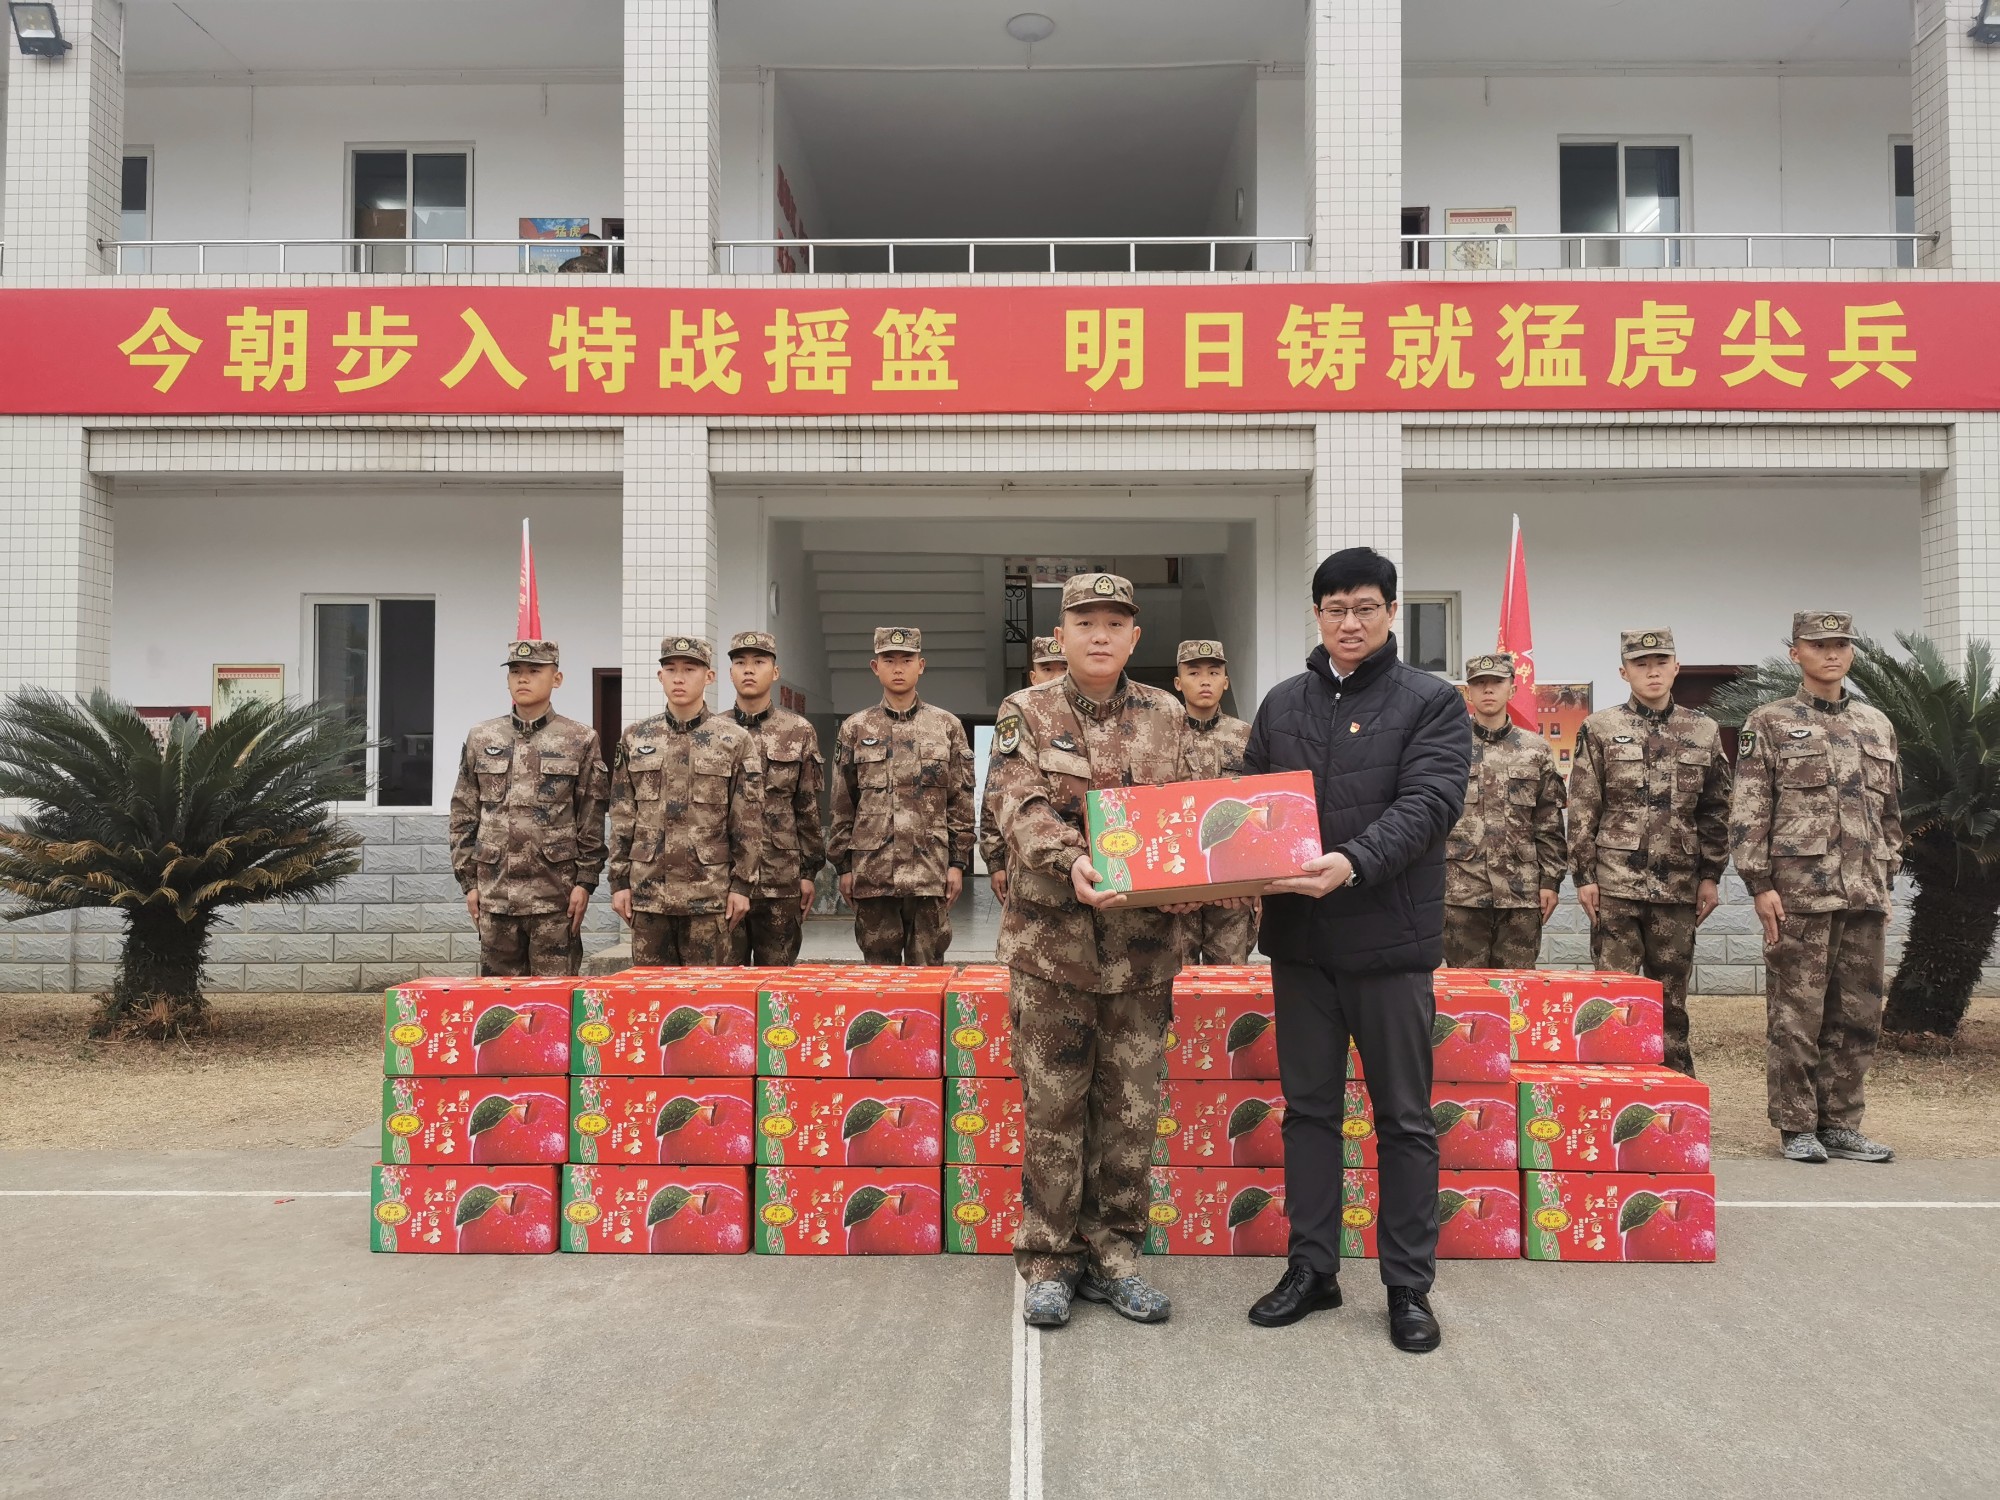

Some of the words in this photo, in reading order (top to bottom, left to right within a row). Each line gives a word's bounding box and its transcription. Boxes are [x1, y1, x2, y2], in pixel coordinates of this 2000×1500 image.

[555, 225, 581, 238] 猛虎
[118, 306, 958, 394] 今朝步入特战摇篮
[1064, 301, 1917, 391] 明日铸就猛虎尖兵
[1156, 807, 1187, 874] 红富士
[438, 1009, 461, 1064] 红富士
[625, 1009, 647, 1063] 红富士
[812, 1014, 833, 1068] 红富士
[1193, 1015, 1214, 1070] 红富士
[1542, 1000, 1561, 1052] 红富士
[436, 1099, 457, 1154] 红富士
[621, 1099, 644, 1155] 红富士
[810, 1103, 830, 1157] 红富士
[1001, 1100, 1023, 1154] 红富士
[1195, 1101, 1214, 1156] 红富士
[1578, 1105, 1601, 1161] 红富士
[421, 1188, 446, 1244] 红富士
[614, 1187, 635, 1244] 红富士
[810, 1190, 831, 1245] 红富士
[1195, 1190, 1215, 1245] 红富士
[1583, 1194, 1605, 1251] 红富士
